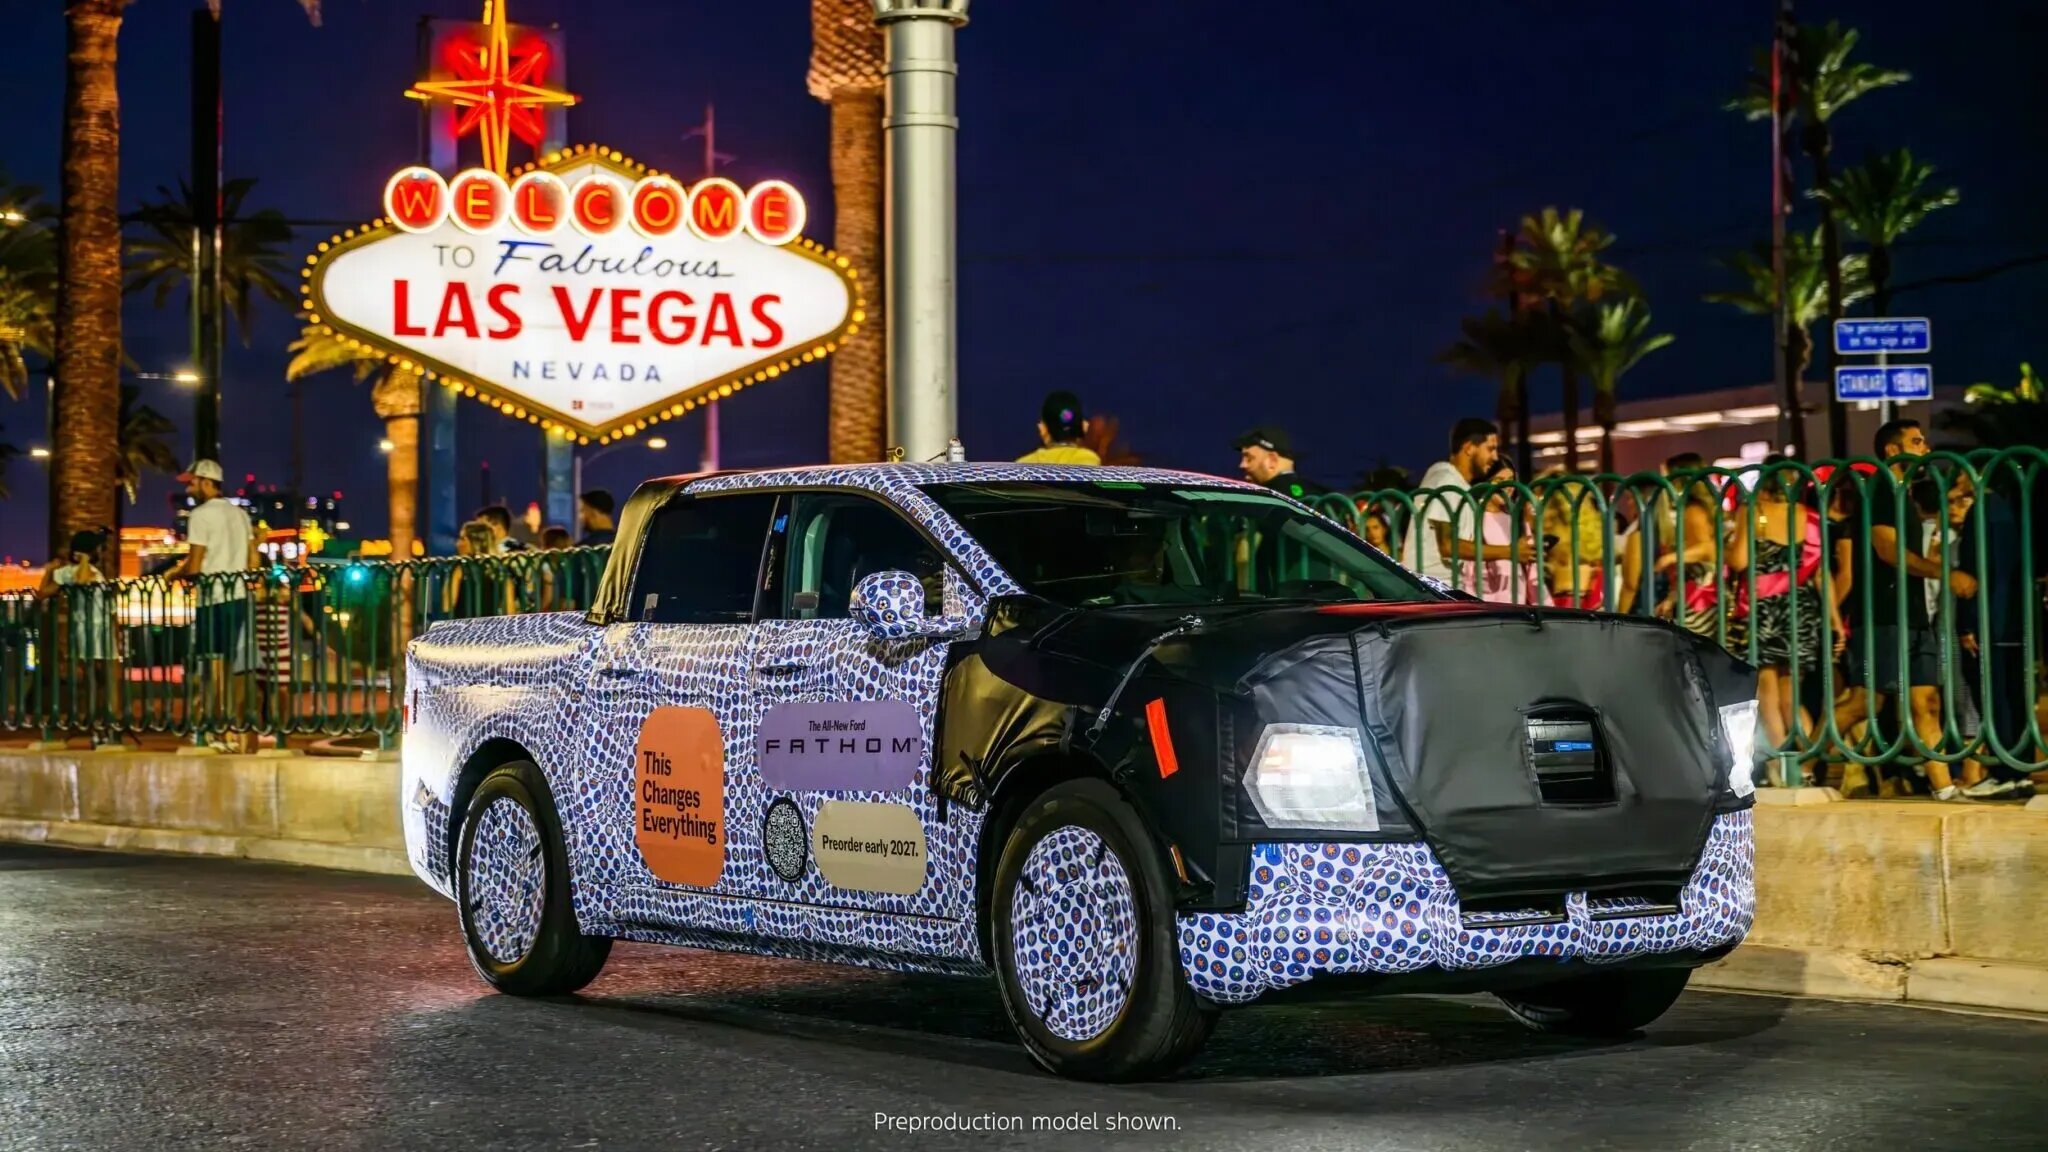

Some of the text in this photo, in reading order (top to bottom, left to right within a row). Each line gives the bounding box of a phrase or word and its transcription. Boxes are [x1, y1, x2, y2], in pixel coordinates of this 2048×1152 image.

[398, 183, 787, 231] WELCOME
[433, 240, 735, 278] TO Fabulous
[393, 279, 785, 349] LAS VEGAS
[513, 360, 662, 383] NEVADA
[809, 719, 866, 731] The All-New Ford
[643, 751, 672, 776] This
[642, 780, 701, 812] Changes
[642, 808, 717, 844] Everything
[822, 835, 919, 858] Preorder early 2027.
